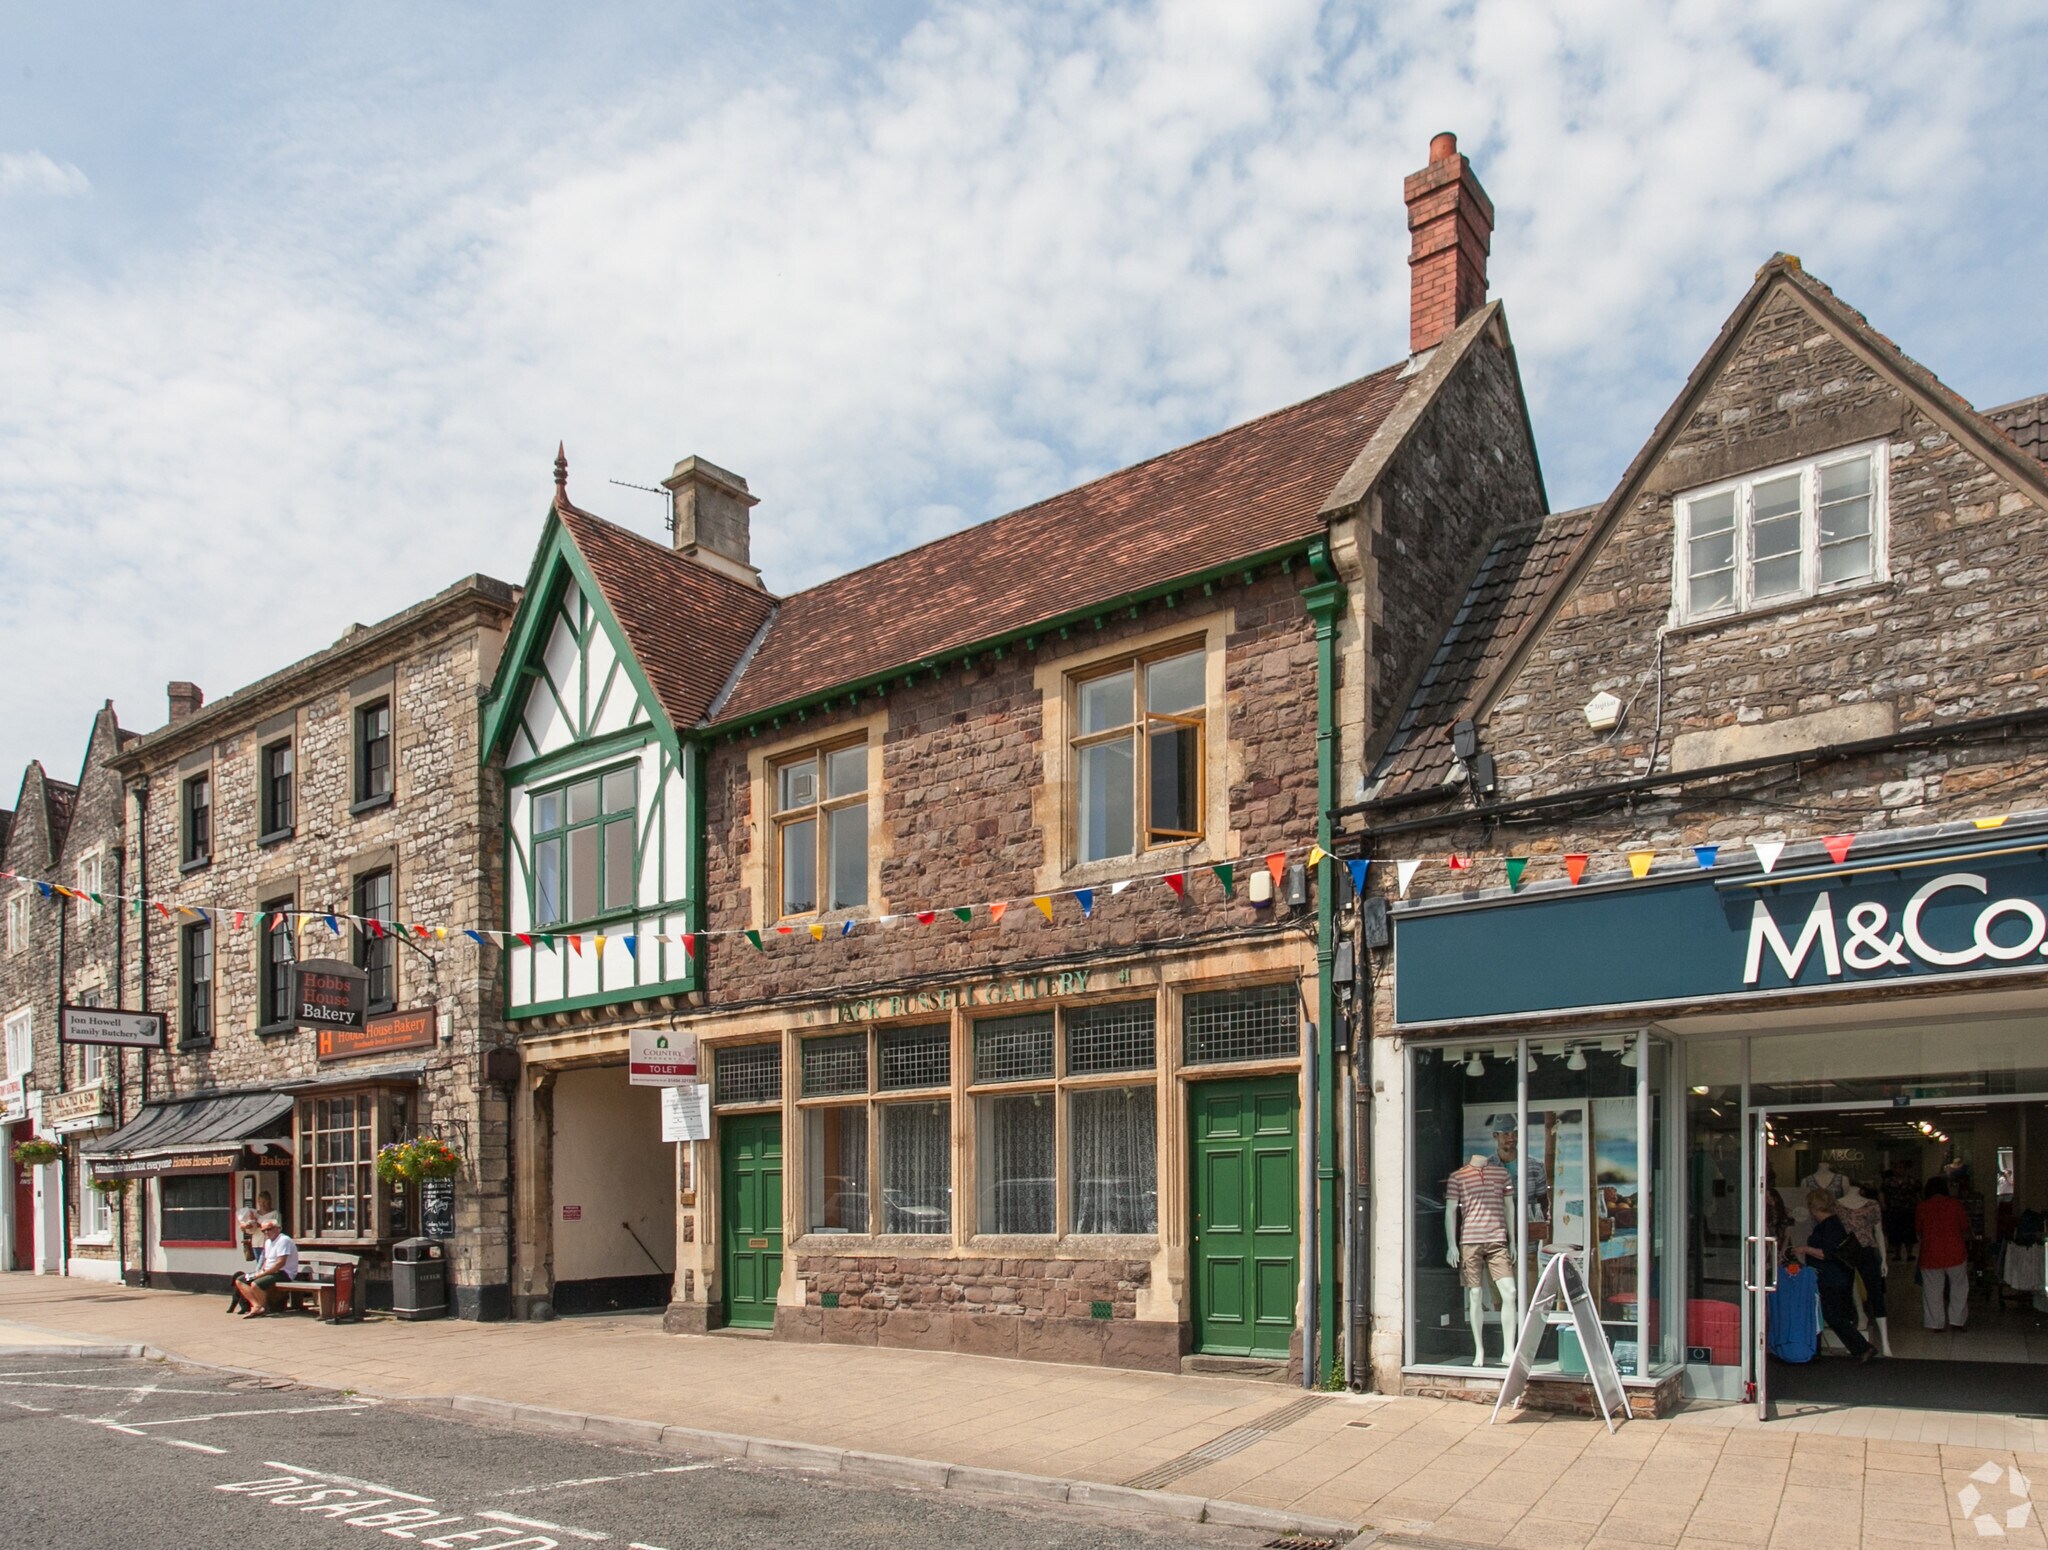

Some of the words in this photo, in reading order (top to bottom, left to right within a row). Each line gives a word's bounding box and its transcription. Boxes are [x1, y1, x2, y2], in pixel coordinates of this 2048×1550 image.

[303, 972, 352, 992] Hobbs
[303, 988, 350, 1007] House
[837, 997, 881, 1024] JACK
[889, 984, 978, 1018] RUSSELL
[985, 969, 1090, 1005] GALLERY
[70, 1015, 87, 1025] Jon
[89, 1016, 121, 1027] Howell
[302, 1003, 356, 1024] Bakery
[71, 1027, 100, 1037] Family
[102, 1029, 138, 1039] Butchery
[366, 1023, 394, 1038] House
[394, 1017, 426, 1034] Bakery
[320, 1030, 333, 1055] H
[649, 1065, 661, 1073] TO
[662, 1065, 677, 1073] LET
[146, 1158, 172, 1172] everyone
[172, 1156, 192, 1168] Hobbs
[192, 1155, 212, 1167] House
[212, 1153, 235, 1167] Bakery
[259, 1155, 292, 1166] Baker
[214, 1476, 560, 1550] DISABLED
